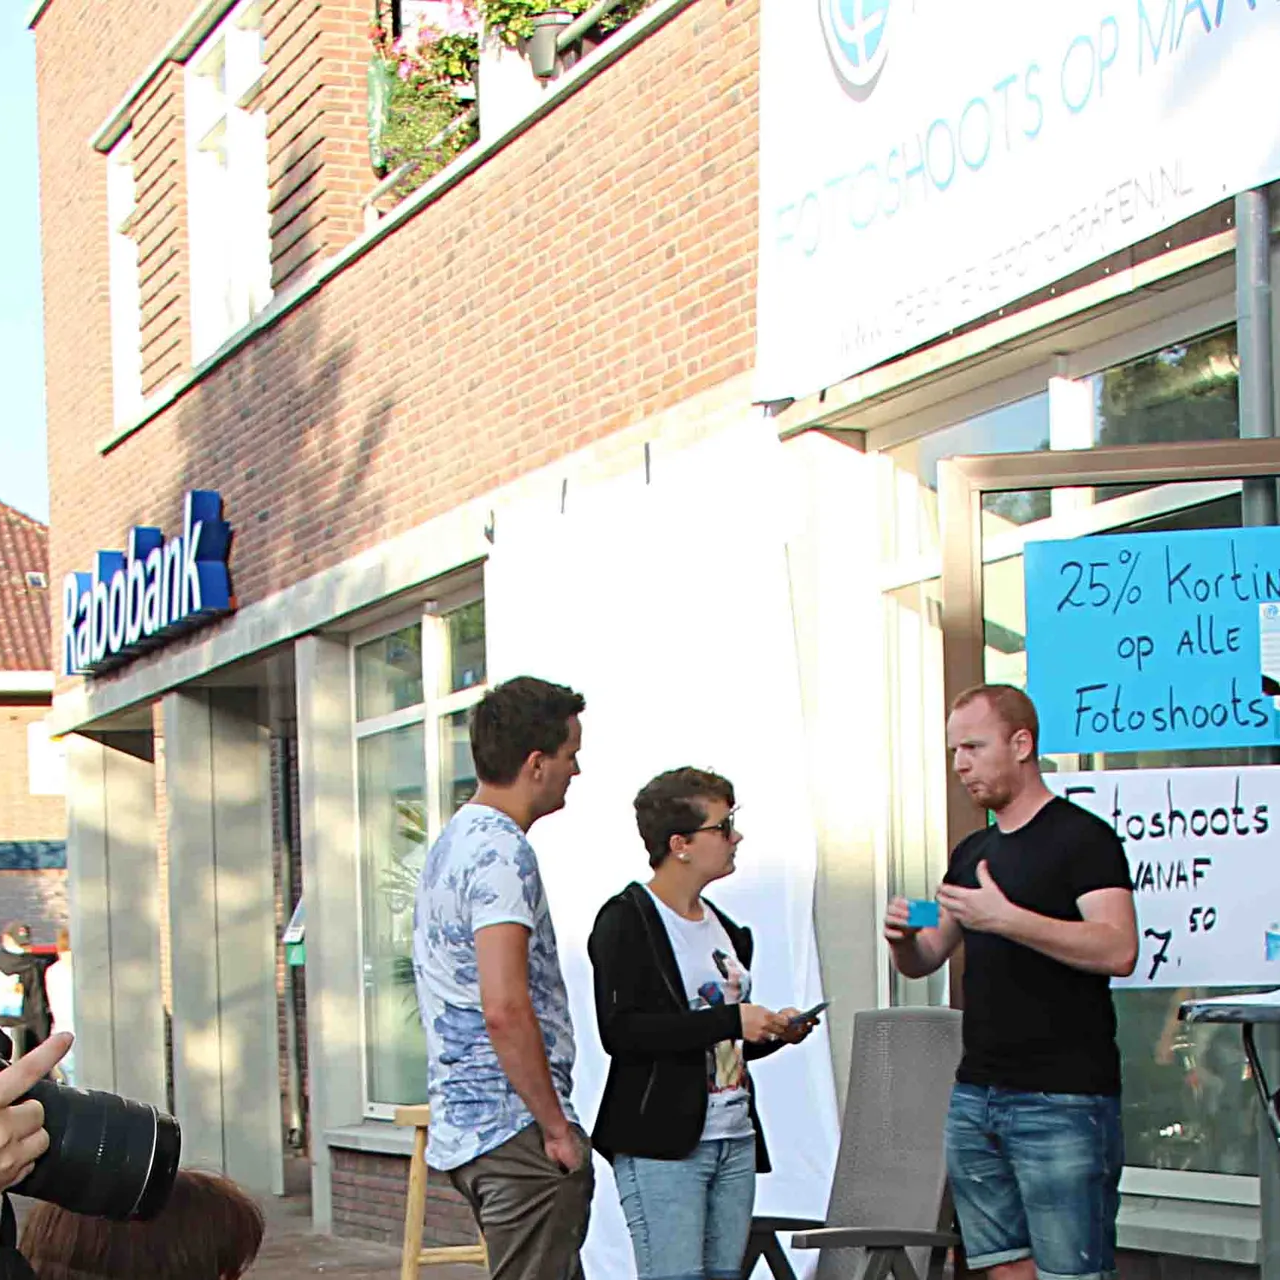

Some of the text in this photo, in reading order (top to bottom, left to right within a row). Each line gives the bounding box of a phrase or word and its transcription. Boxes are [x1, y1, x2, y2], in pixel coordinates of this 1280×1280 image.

[776, 62, 1044, 258] FOTOSHOOTS
[1060, 14, 1120, 115] OP
[62, 491, 204, 672] Rabobank
[1056, 549, 1143, 615] 25%
[1074, 677, 1270, 737] Fotoshoots
[1064, 776, 1270, 844] toshoots
